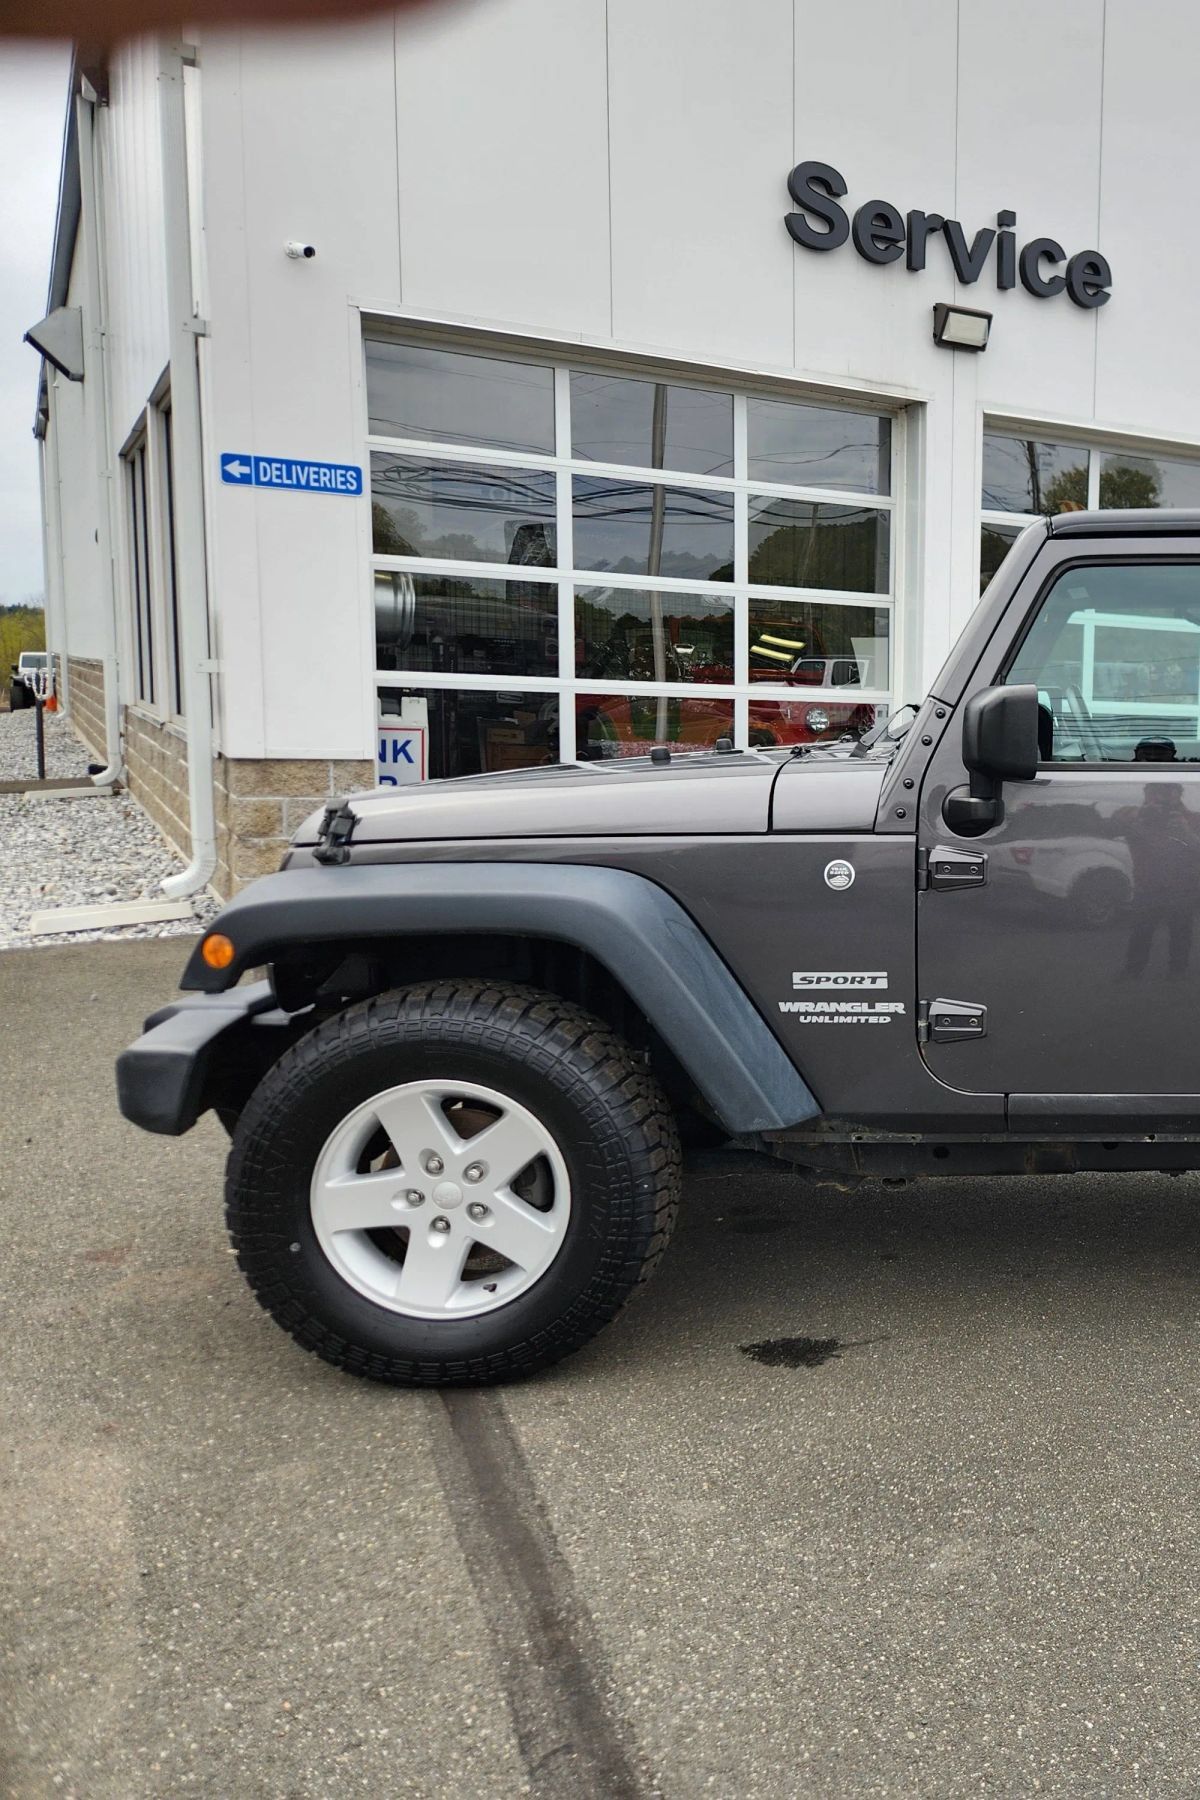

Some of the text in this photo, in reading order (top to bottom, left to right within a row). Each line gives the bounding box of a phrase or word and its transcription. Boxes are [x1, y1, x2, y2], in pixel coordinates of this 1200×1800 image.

[783, 160, 1113, 309] Service
[259, 461, 358, 491] DELIVERIES
[793, 975, 887, 986] SPORT
[778, 1001, 907, 1014] WRANGLER
[799, 1015, 892, 1024] UNLIMITED
